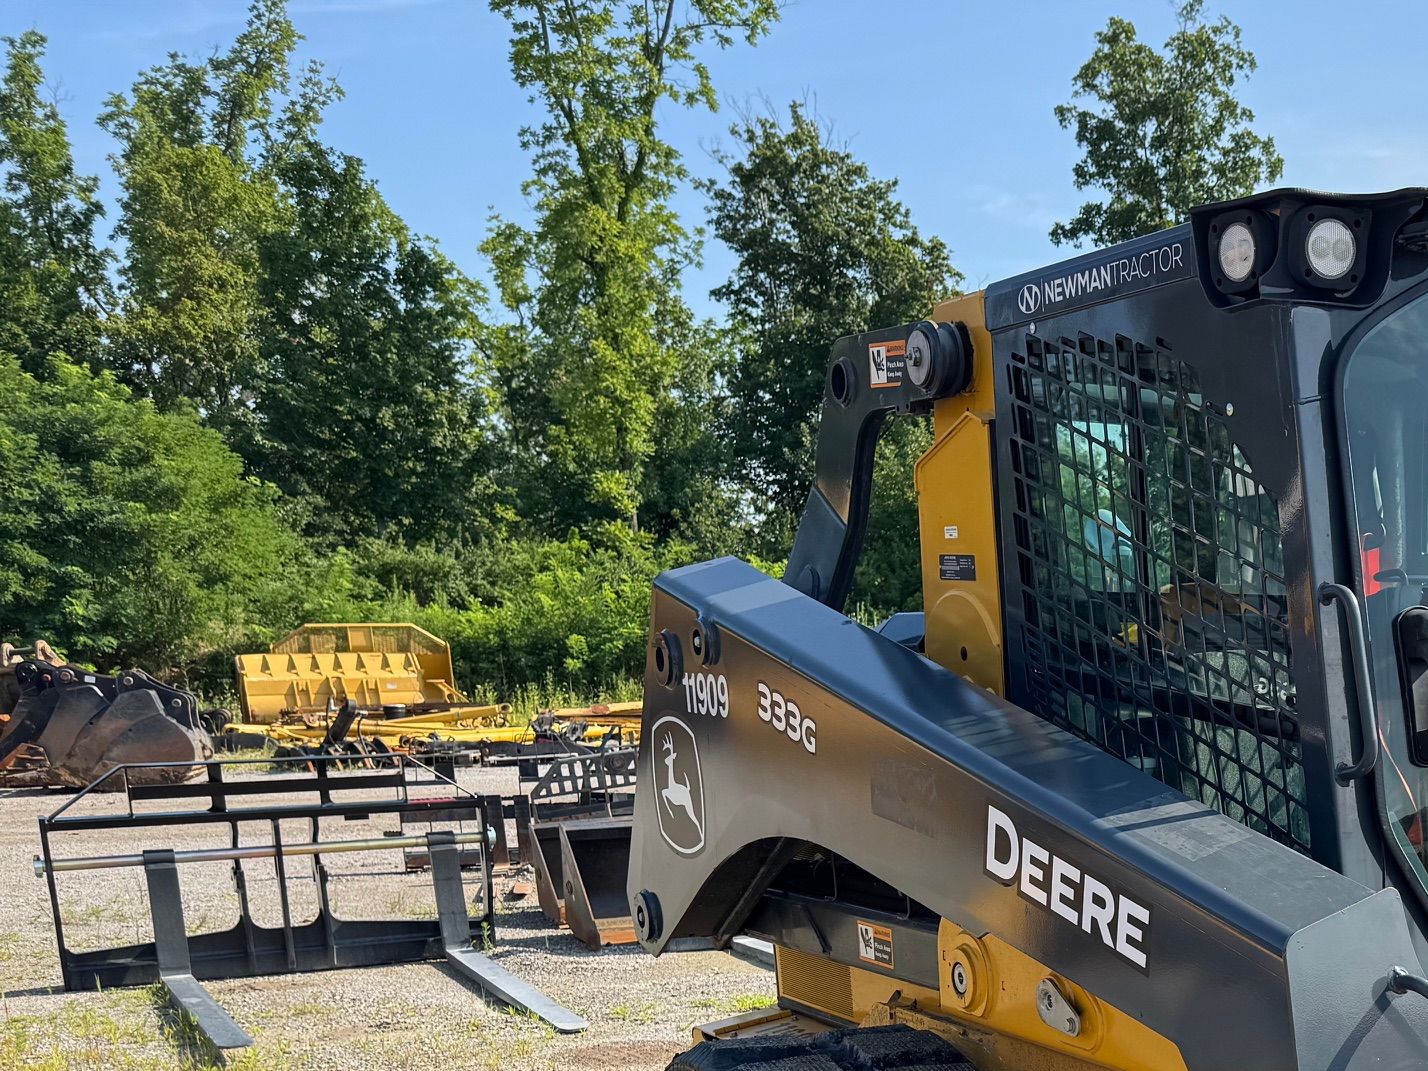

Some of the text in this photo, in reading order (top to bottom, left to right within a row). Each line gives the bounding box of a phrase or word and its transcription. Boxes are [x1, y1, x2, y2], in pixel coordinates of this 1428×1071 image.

[682, 672, 729, 719] 11909
[758, 682, 816, 754] 333G
[986, 804, 1150, 969] DEERE
